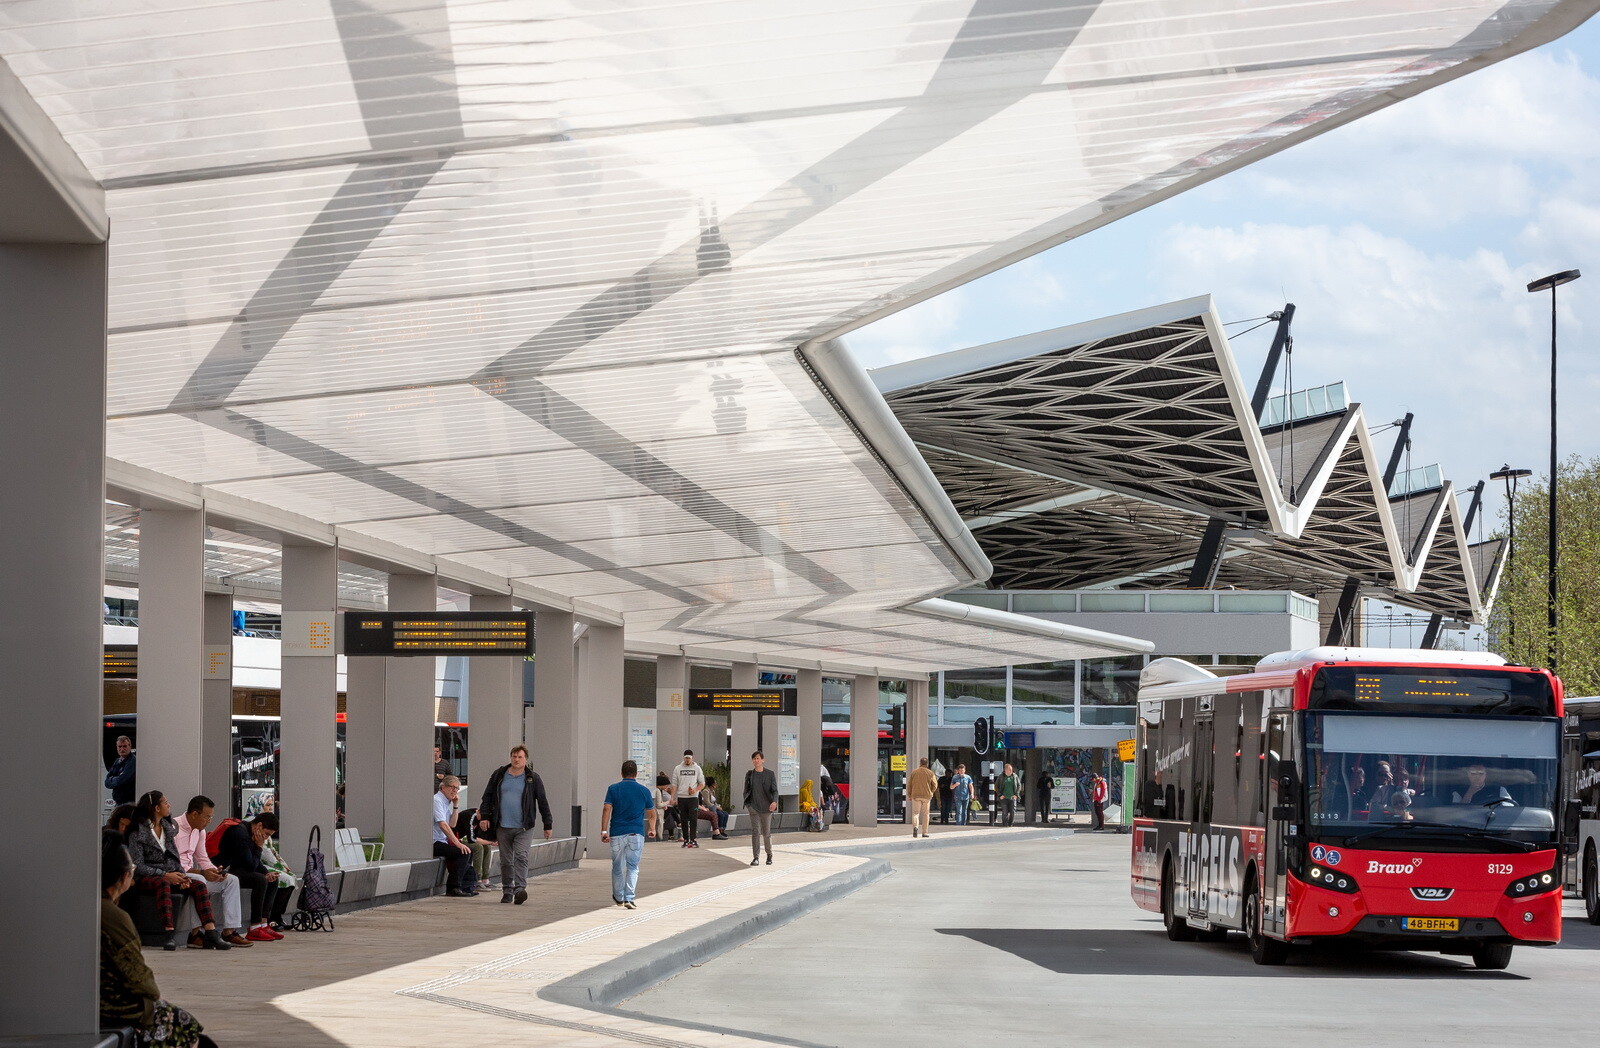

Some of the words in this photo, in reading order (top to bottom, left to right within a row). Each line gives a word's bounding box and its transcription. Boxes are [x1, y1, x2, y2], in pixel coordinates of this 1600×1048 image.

[309, 622, 330, 648] B
[210, 652, 227, 674] F
[670, 693, 682, 708] A
[1313, 812, 1339, 820] 2313
[1366, 860, 1415, 875] Bravo
[1487, 863, 1513, 875] 8129
[1416, 888, 1447, 898] VDL
[1410, 918, 1456, 930] 48-BFH-4
